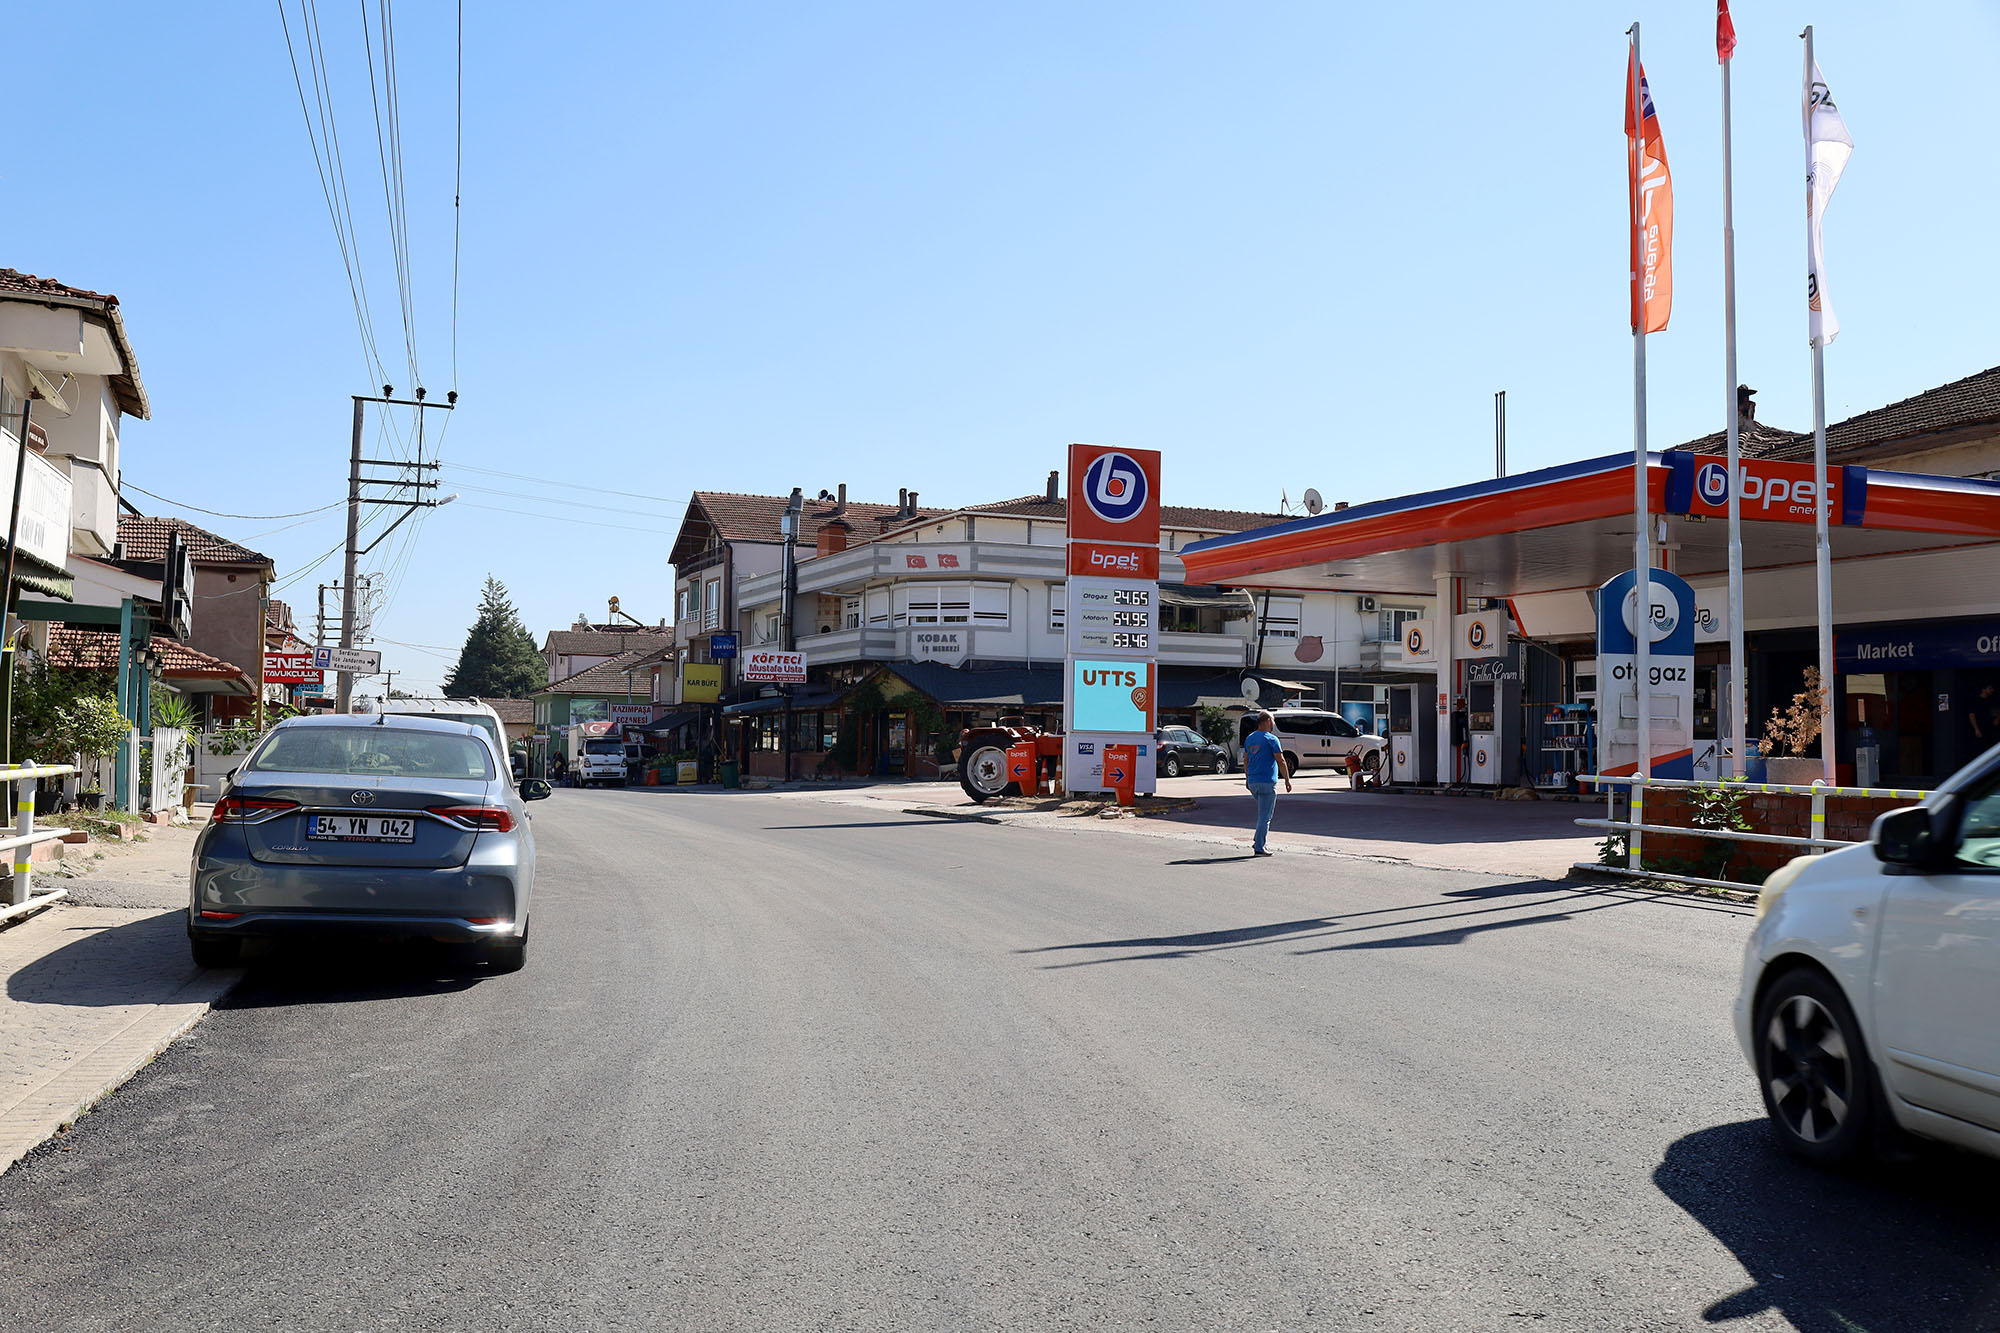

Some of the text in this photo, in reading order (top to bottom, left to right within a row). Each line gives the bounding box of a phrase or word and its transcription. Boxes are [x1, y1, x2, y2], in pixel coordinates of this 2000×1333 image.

[1789, 505, 1832, 518] enery
[1091, 550, 1139, 569] bpet
[1114, 590, 1148, 605] 24.65
[1114, 612, 1148, 627] 54.95
[917, 634, 957, 642] KOBAK
[1114, 633, 1147, 648] 53.46
[1857, 635, 2000, 659] Market Of
[752, 652, 802, 664] KÖFTECİ
[749, 664, 803, 673] Mustafa Usta
[1612, 662, 1686, 685] otgaz
[701, 679, 718, 687] BÜFE
[1083, 669, 1137, 687] UTTS
[1108, 752, 1128, 760] bpet
[317, 818, 337, 834] 54
[349, 818, 368, 834] YN
[380, 819, 410, 836] 042
